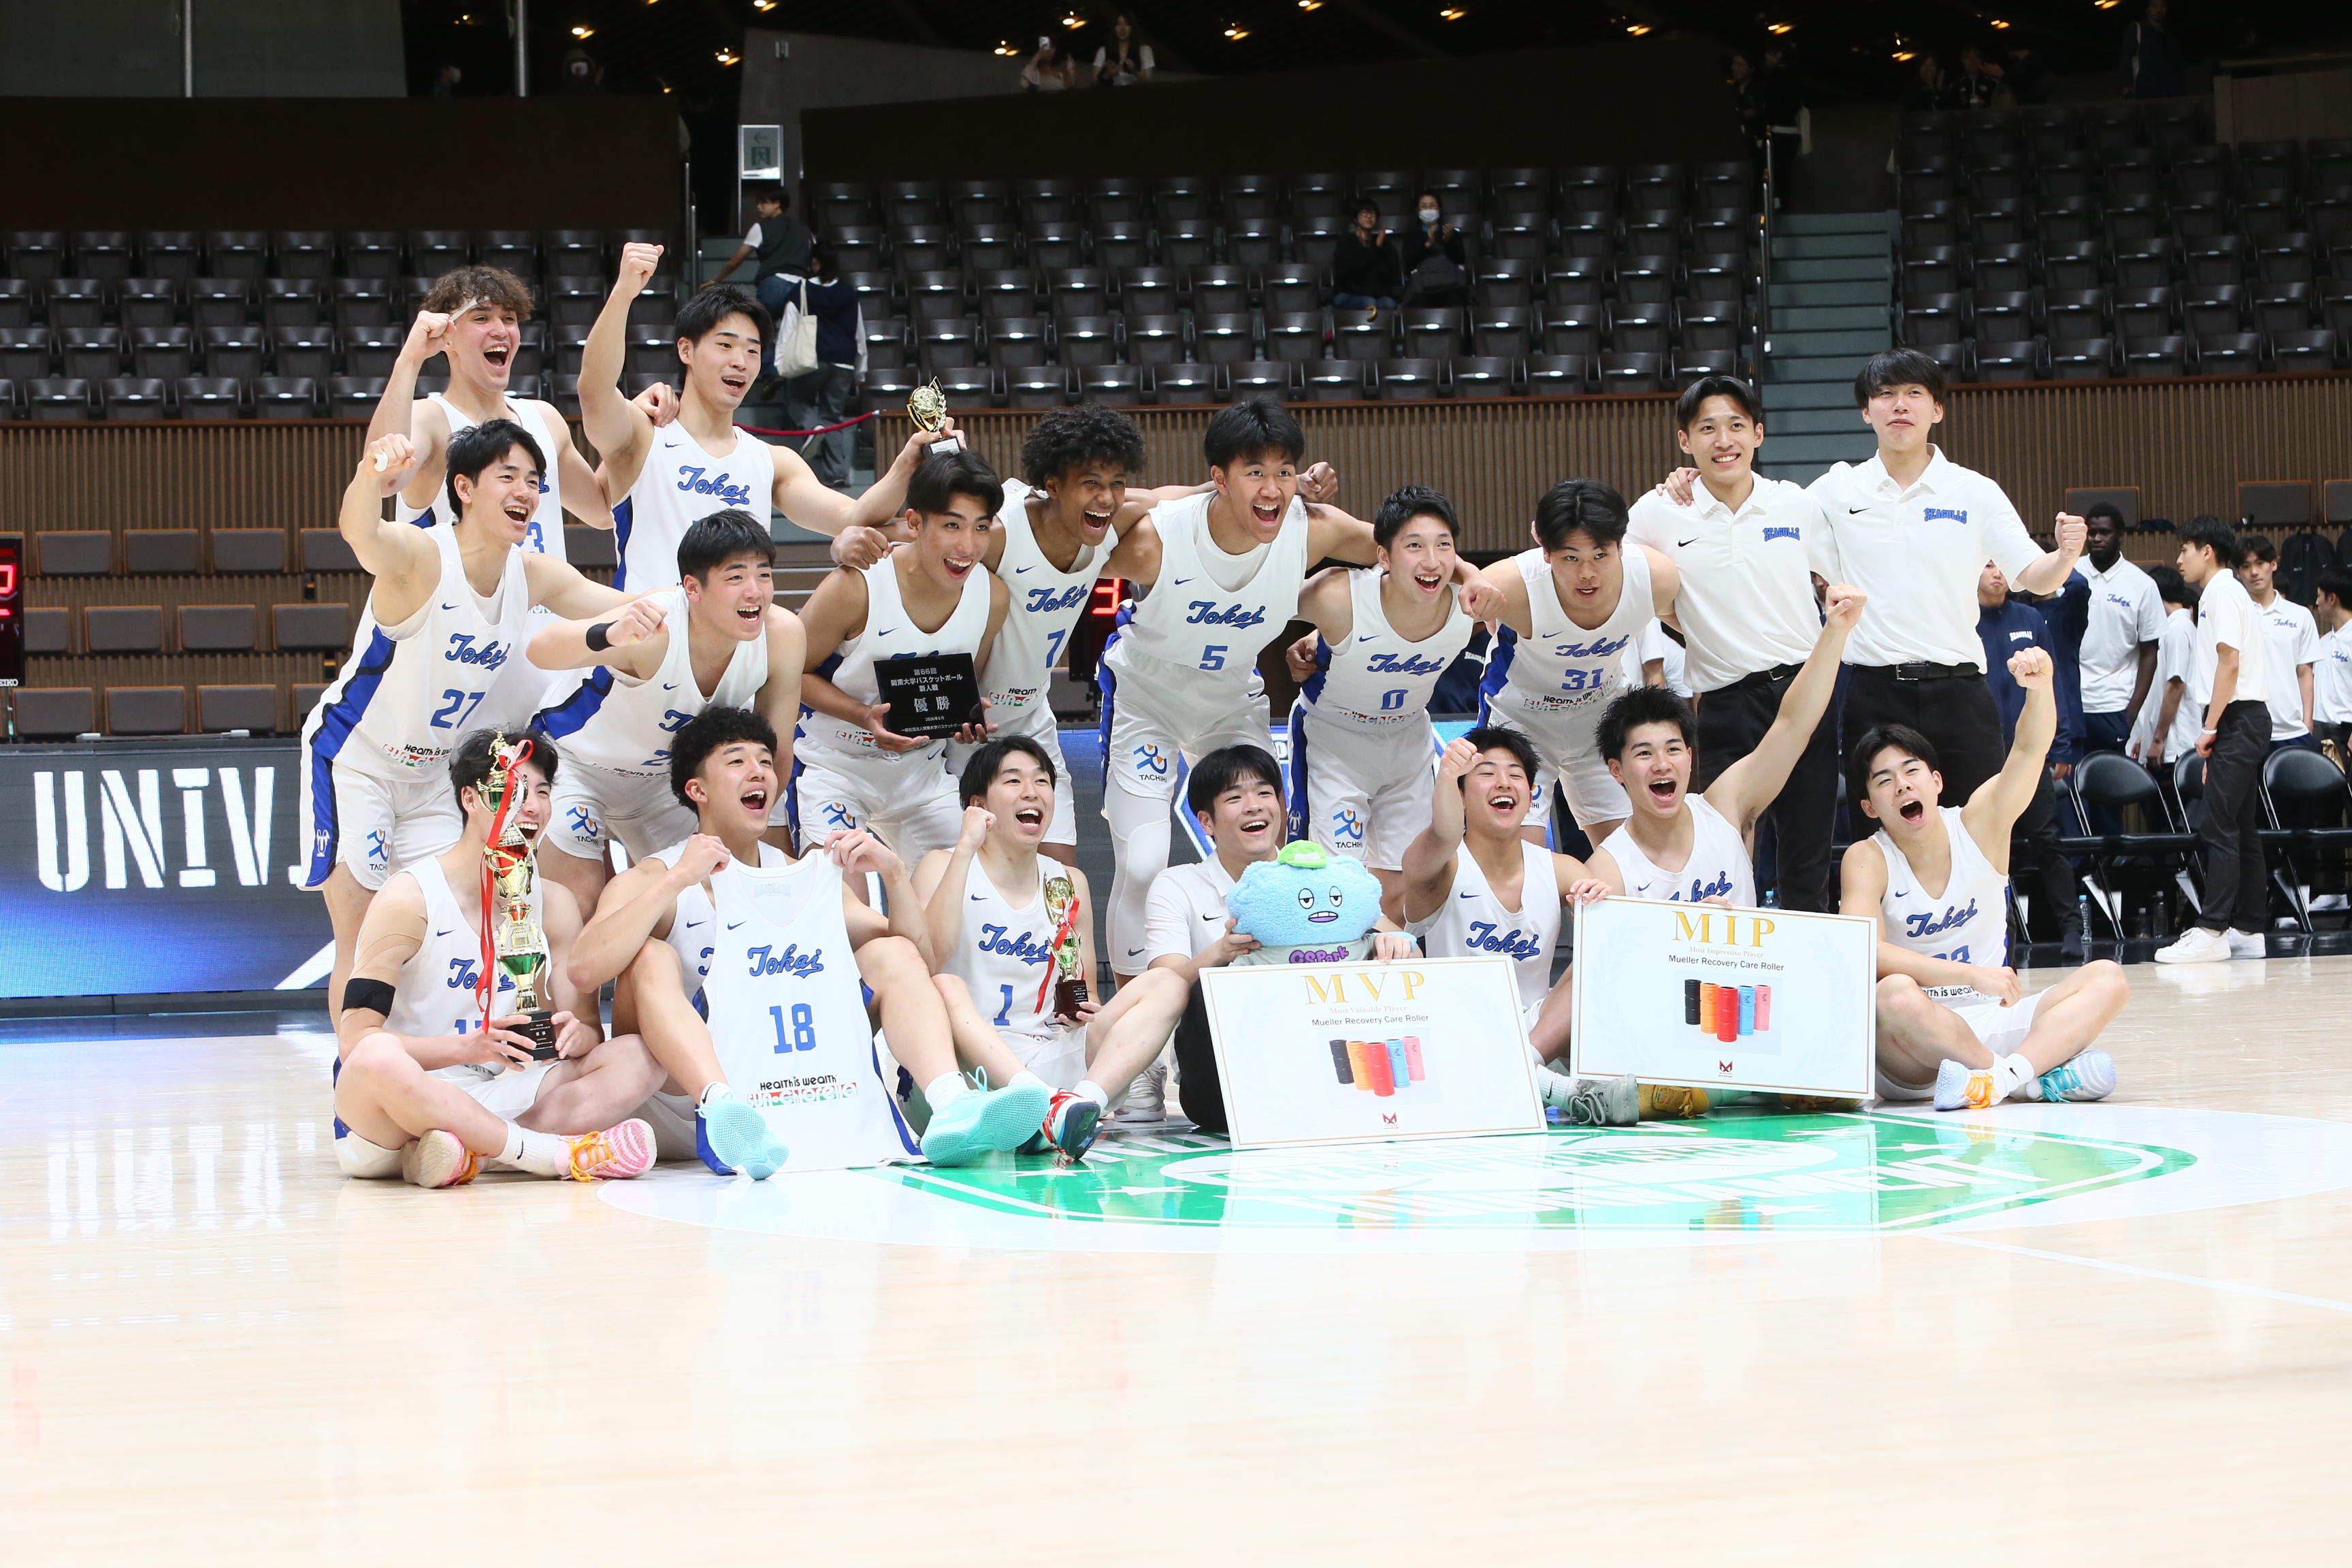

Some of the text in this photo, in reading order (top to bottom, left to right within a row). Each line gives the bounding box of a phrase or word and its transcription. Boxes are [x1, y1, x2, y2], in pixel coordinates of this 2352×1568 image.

[678, 466, 750, 506] Tokai
[1923, 508, 1967, 525] SEAGULLS
[1763, 527, 1800, 542] SEAGULLS
[2107, 593, 2132, 607] Tokai
[1186, 601, 1266, 630] Tokai
[2274, 619, 2298, 629] Tokai
[1555, 634, 1630, 657] Tokai
[2009, 631, 2033, 642] SEAGULLS
[445, 633, 511, 672] Tokai
[1046, 629, 1066, 668] 7
[1199, 645, 1228, 670] 5
[2332, 651, 2349, 663] Tokai
[914, 668, 937, 676] 第66回
[1367, 653, 1445, 676] Tokai
[0, 679, 19, 687] EIKO
[1561, 668, 1604, 690] 31
[430, 689, 486, 729] 27
[1380, 689, 1409, 710] 0
[434, 747, 440, 755] is
[1671, 911, 1776, 947] MIP
[1906, 898, 1978, 938] Tokai
[979, 924, 1050, 966] Tokai
[1466, 921, 1540, 961] Tokai
[1707, 947, 1742, 957] Impressive
[747, 943, 824, 979] Tokai
[1669, 955, 1784, 972] Mueller Recovery Care Roller
[1300, 970, 1424, 1004] MVP
[1941, 987, 1948, 996] is
[994, 984, 1013, 1026] 1
[1384, 1005, 1407, 1013] Player
[769, 1003, 816, 1054] 18
[1345, 1017, 1382, 1025] Recovery
[794, 1076, 800, 1087] is
[1206, 1144, 1792, 1183] CHAMPIONSHIP
[1218, 1154, 2050, 1220] TOURNAMENT
